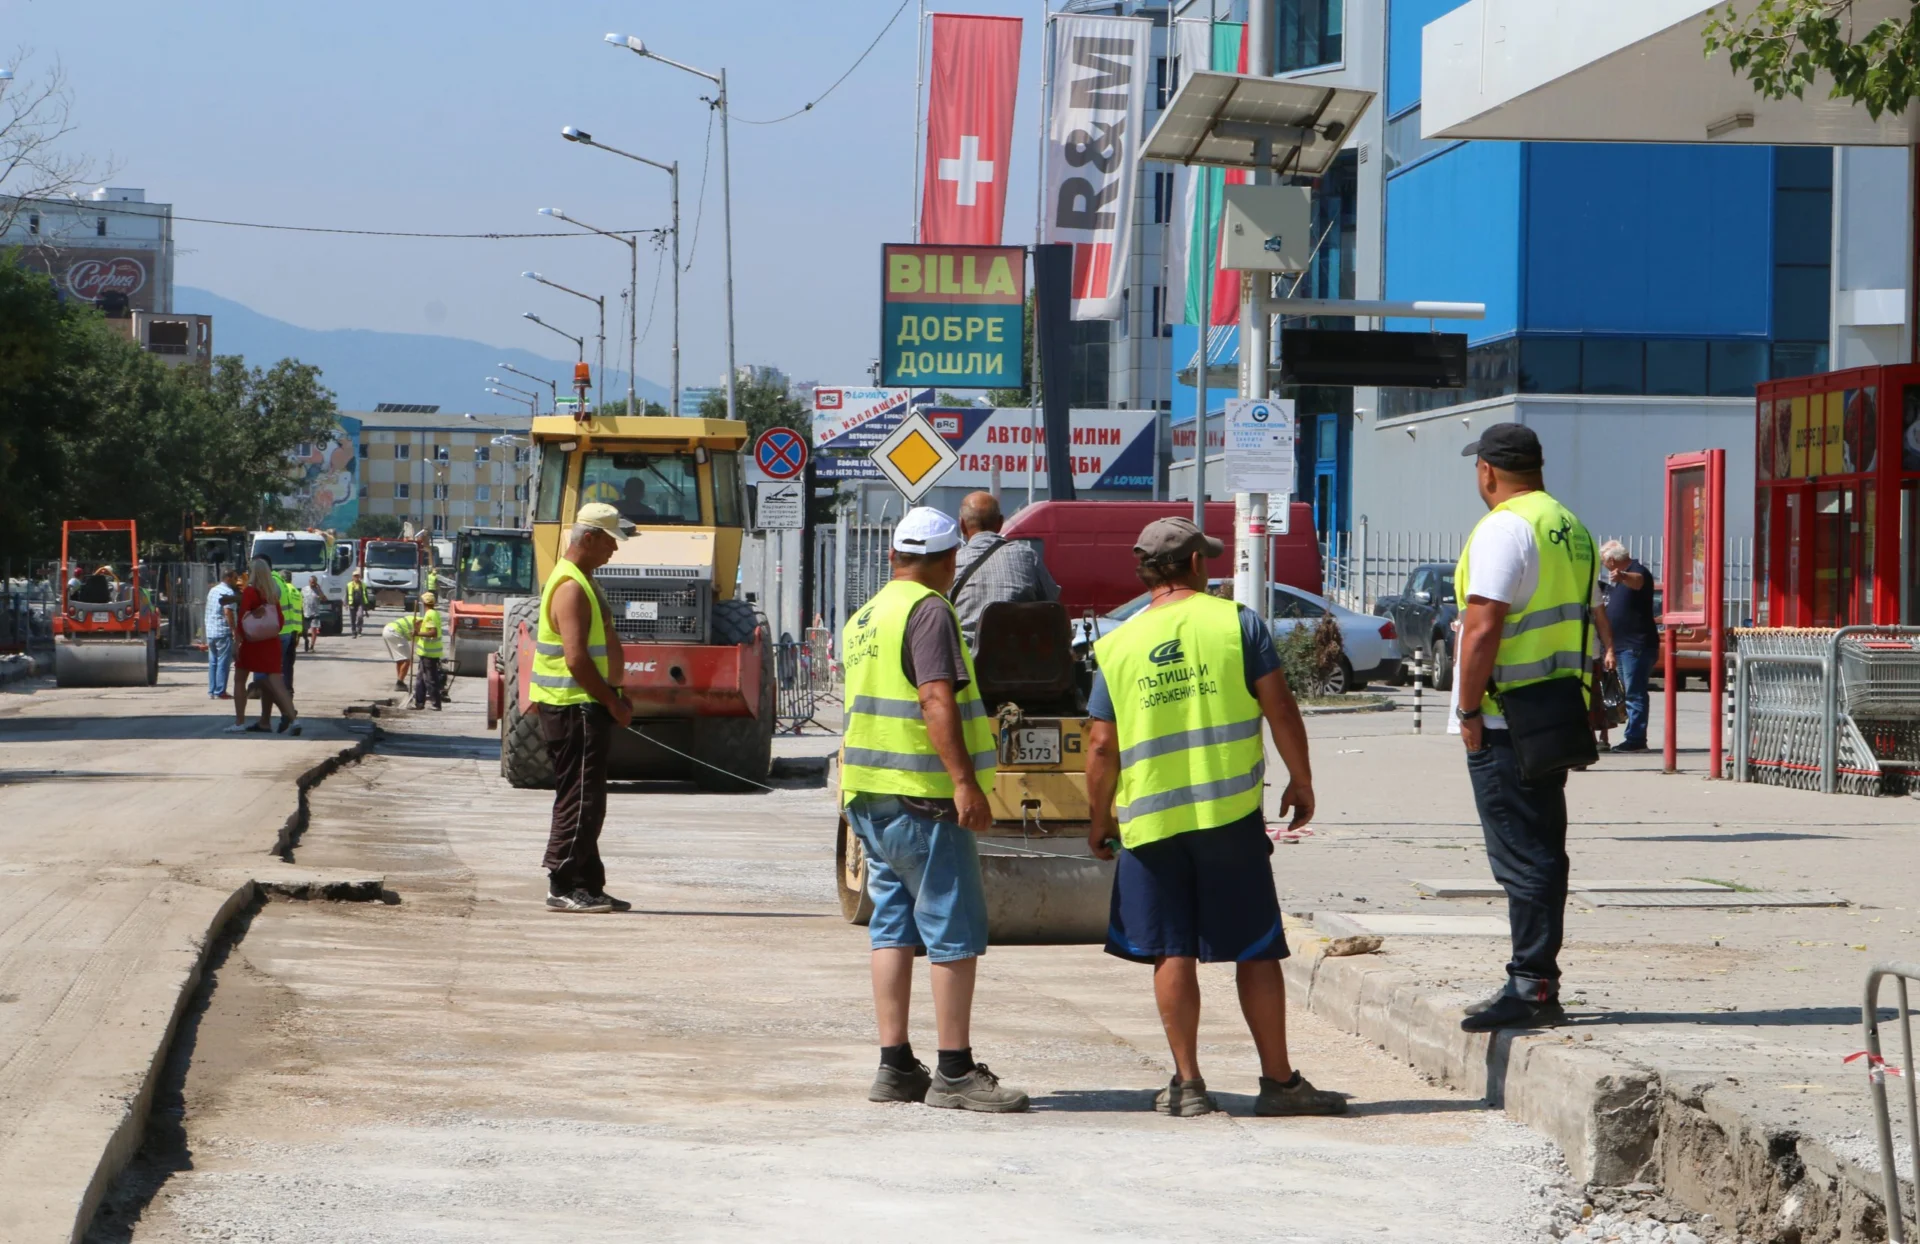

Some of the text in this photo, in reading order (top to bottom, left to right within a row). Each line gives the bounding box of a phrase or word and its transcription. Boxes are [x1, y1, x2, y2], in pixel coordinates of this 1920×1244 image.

[1056, 36, 1134, 229] R&M
[75, 264, 135, 293] София
[889, 254, 1017, 295] BILLA
[897, 316, 1004, 346] ДОБРЕ
[897, 351, 1003, 378] ДОШЛИ
[820, 428, 837, 441] НА
[936, 420, 955, 429] BRC
[987, 426, 1121, 446] АВТОМИЛНИ
[1138, 664, 1208, 692] ПЪТИЩА И
[1199, 681, 1217, 695] ЕАД
[1026, 732, 1035, 743] C
[1019, 748, 1051, 760] 5173
